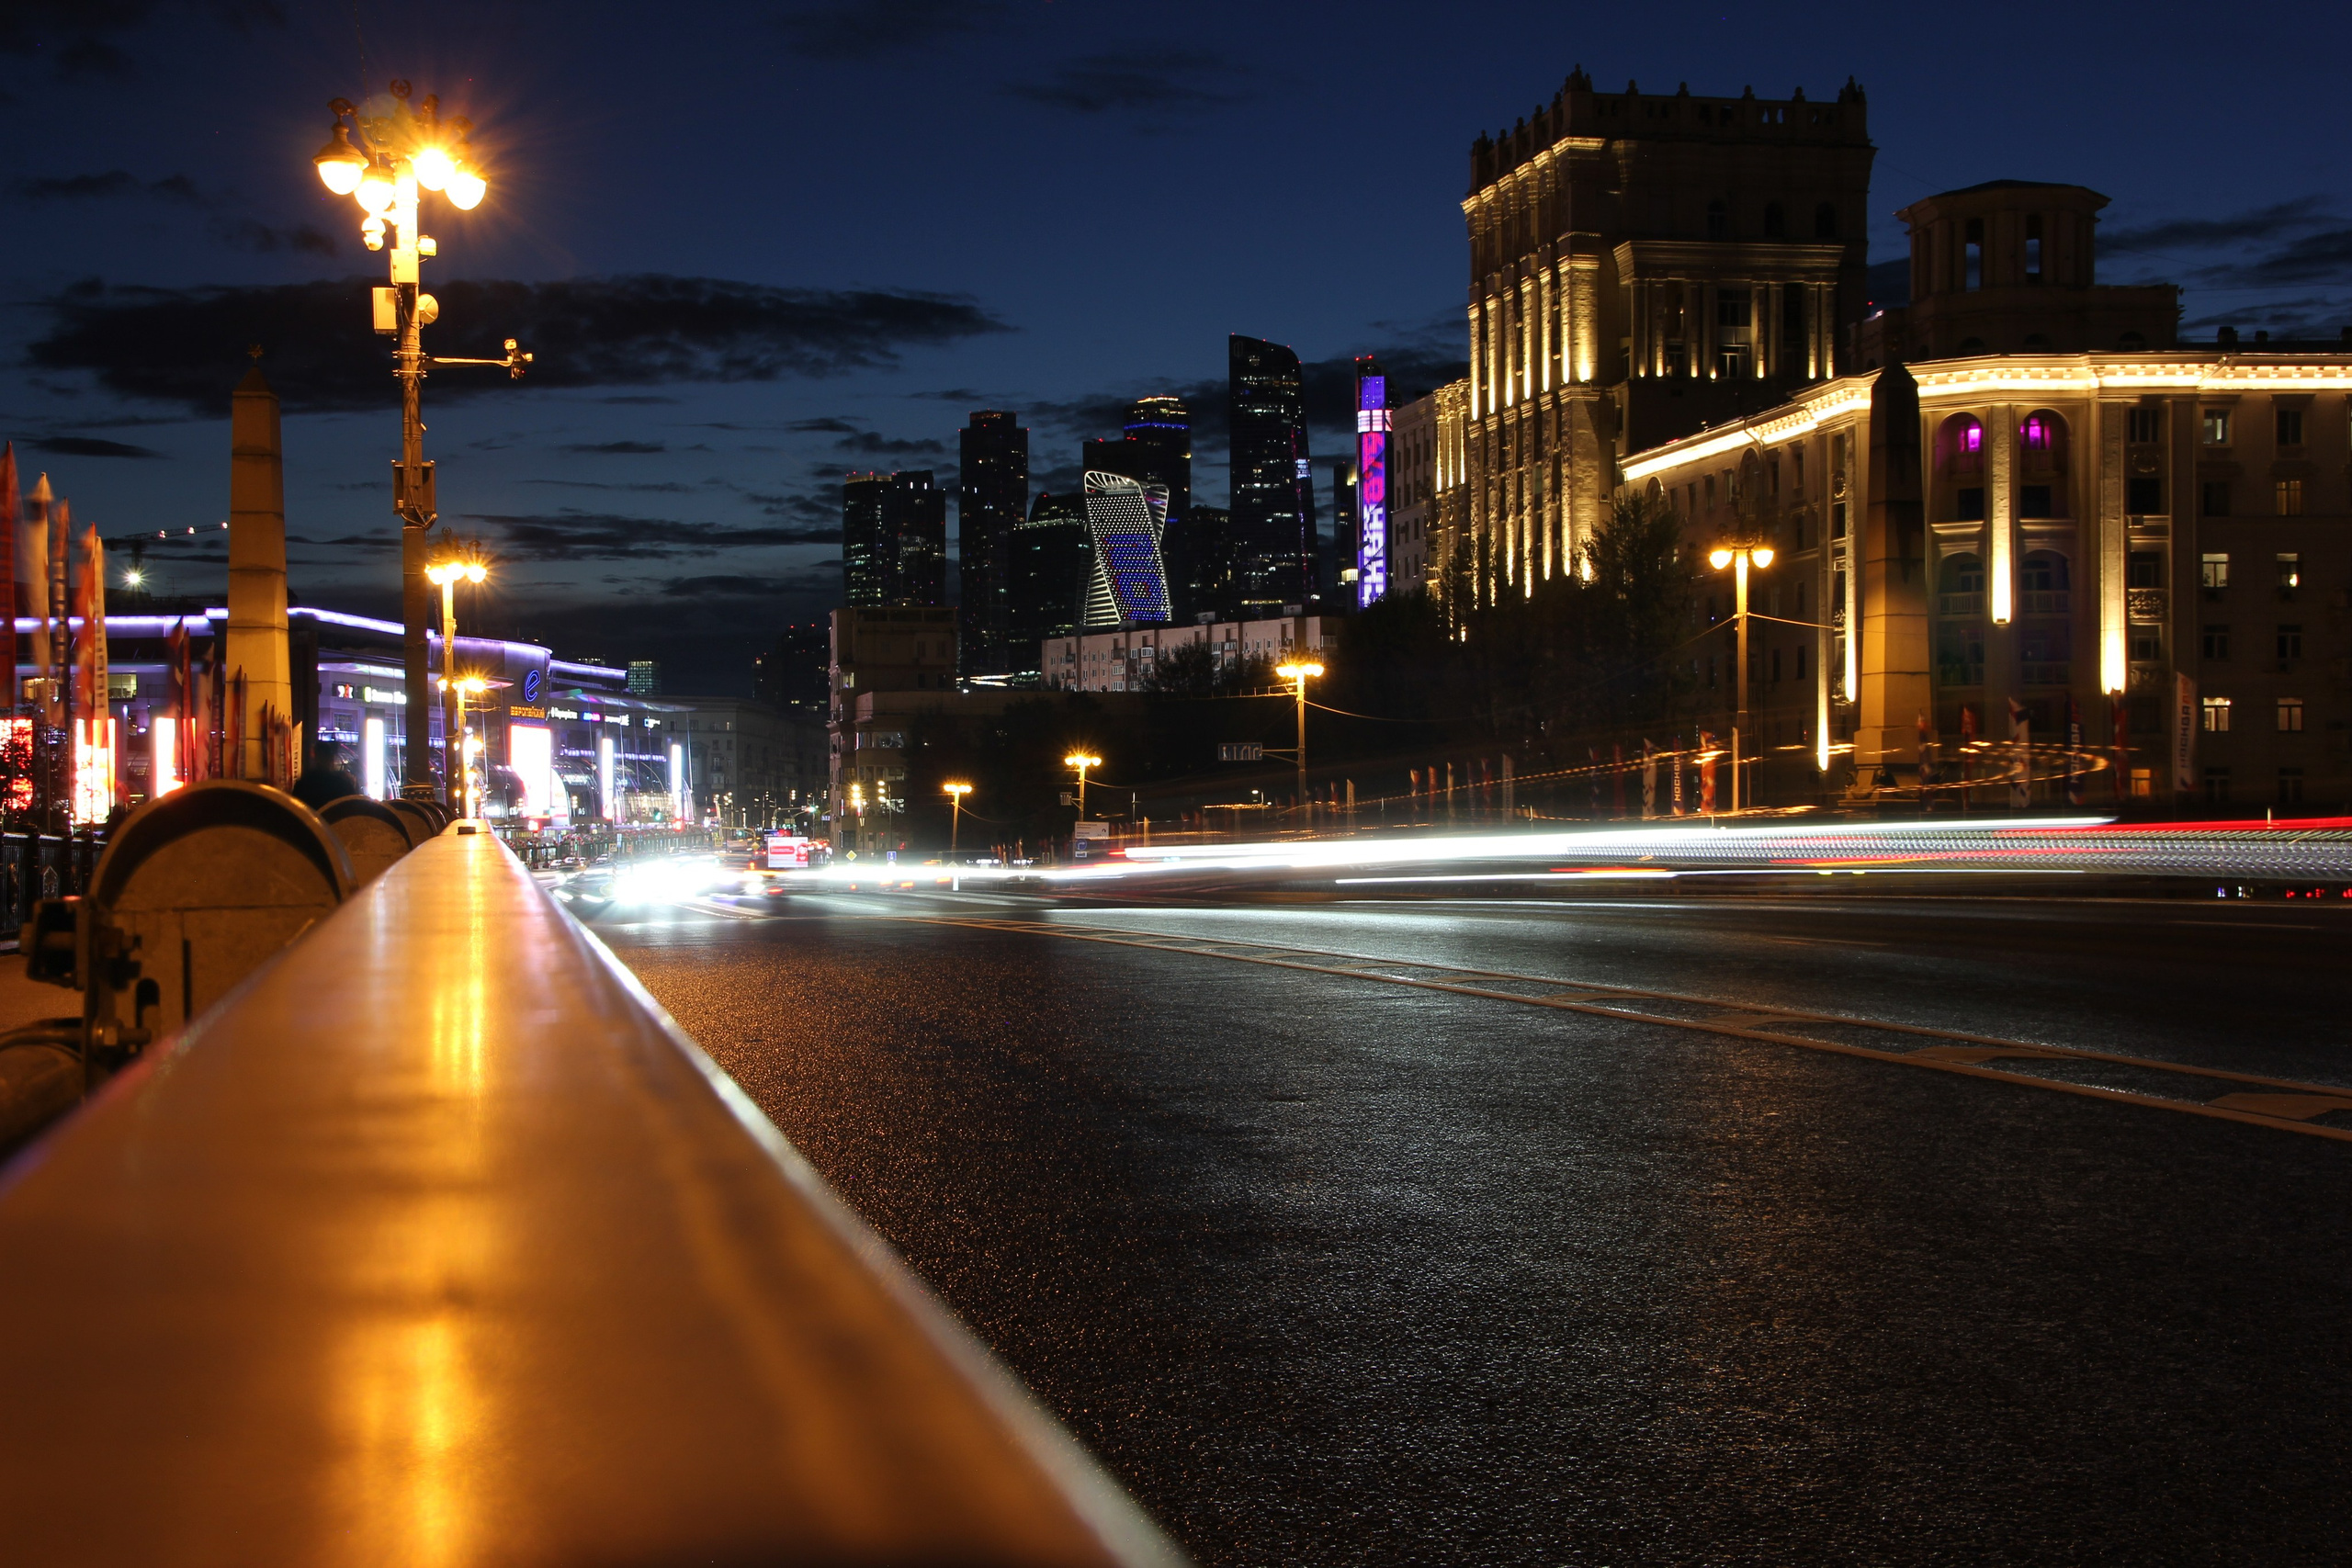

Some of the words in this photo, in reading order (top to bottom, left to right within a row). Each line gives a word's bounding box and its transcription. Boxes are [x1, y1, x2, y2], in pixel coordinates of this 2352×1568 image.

[2071, 722, 2080, 784] МОСКВА
[2179, 705, 2191, 769] МОСКВА
[1673, 756, 1681, 802] МОСКВА
